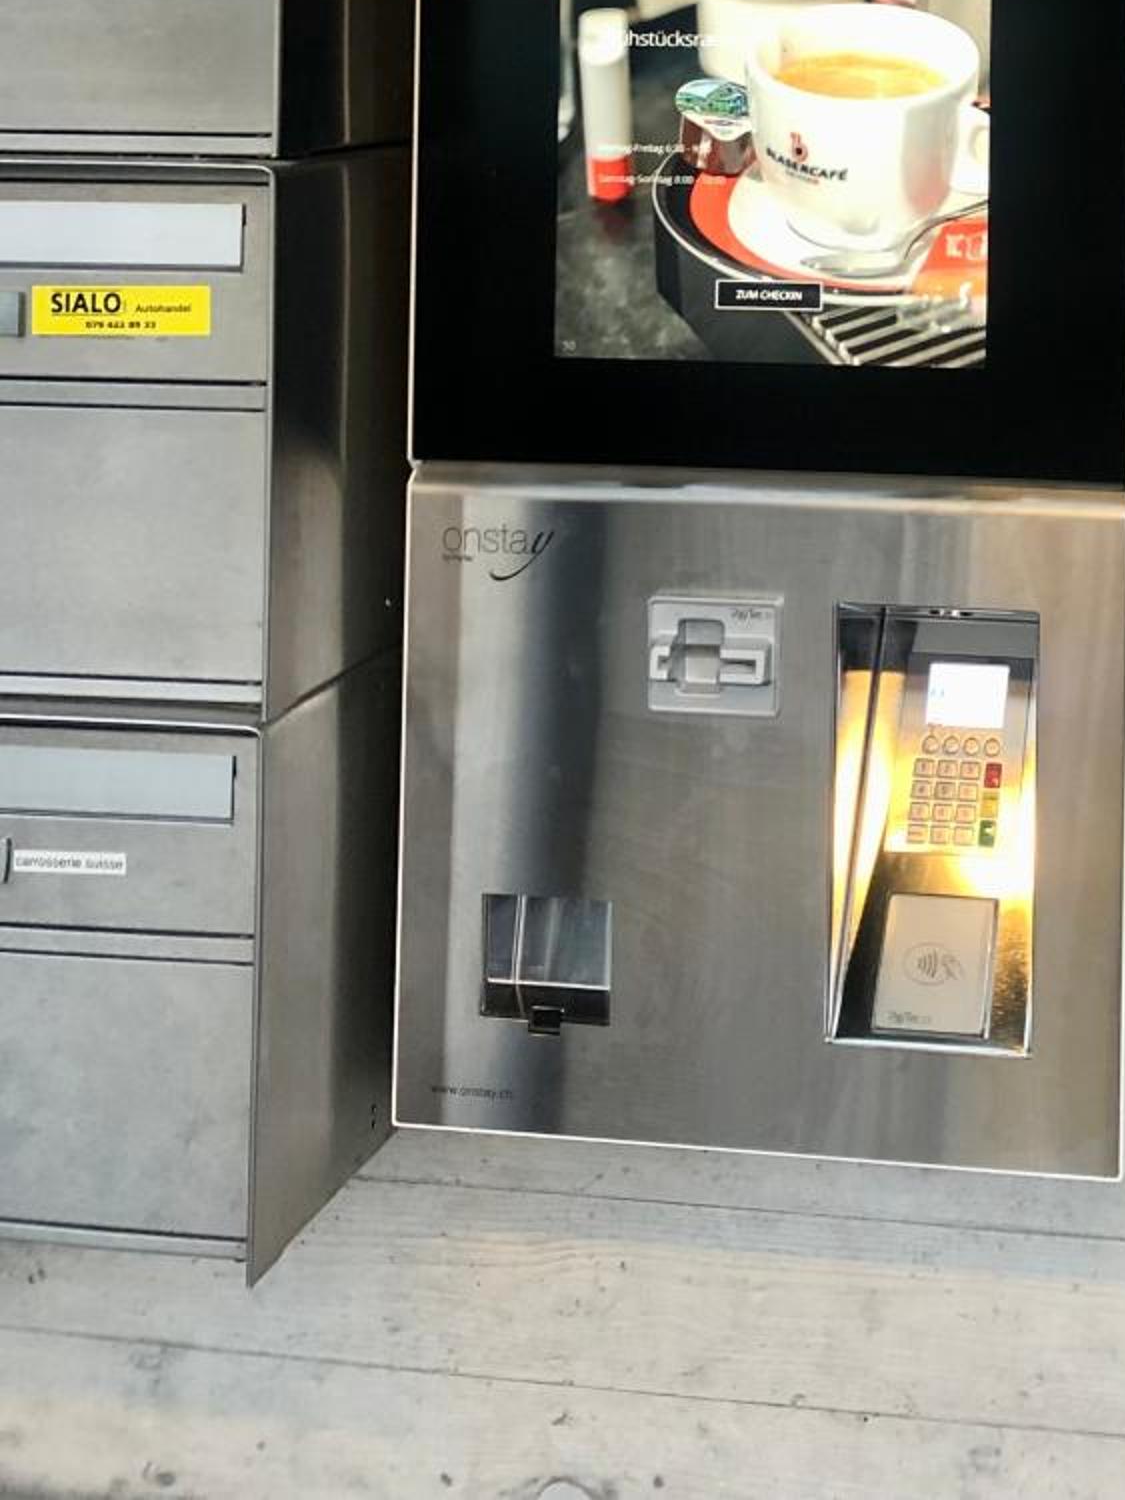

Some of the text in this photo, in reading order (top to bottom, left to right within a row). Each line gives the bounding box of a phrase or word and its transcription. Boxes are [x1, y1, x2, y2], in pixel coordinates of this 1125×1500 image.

[51, 292, 192, 313] SIALO Autohandel
[735, 289, 759, 301] ZUM
[443, 524, 555, 581] onstay
[15, 858, 124, 870] carrosserie suisse
